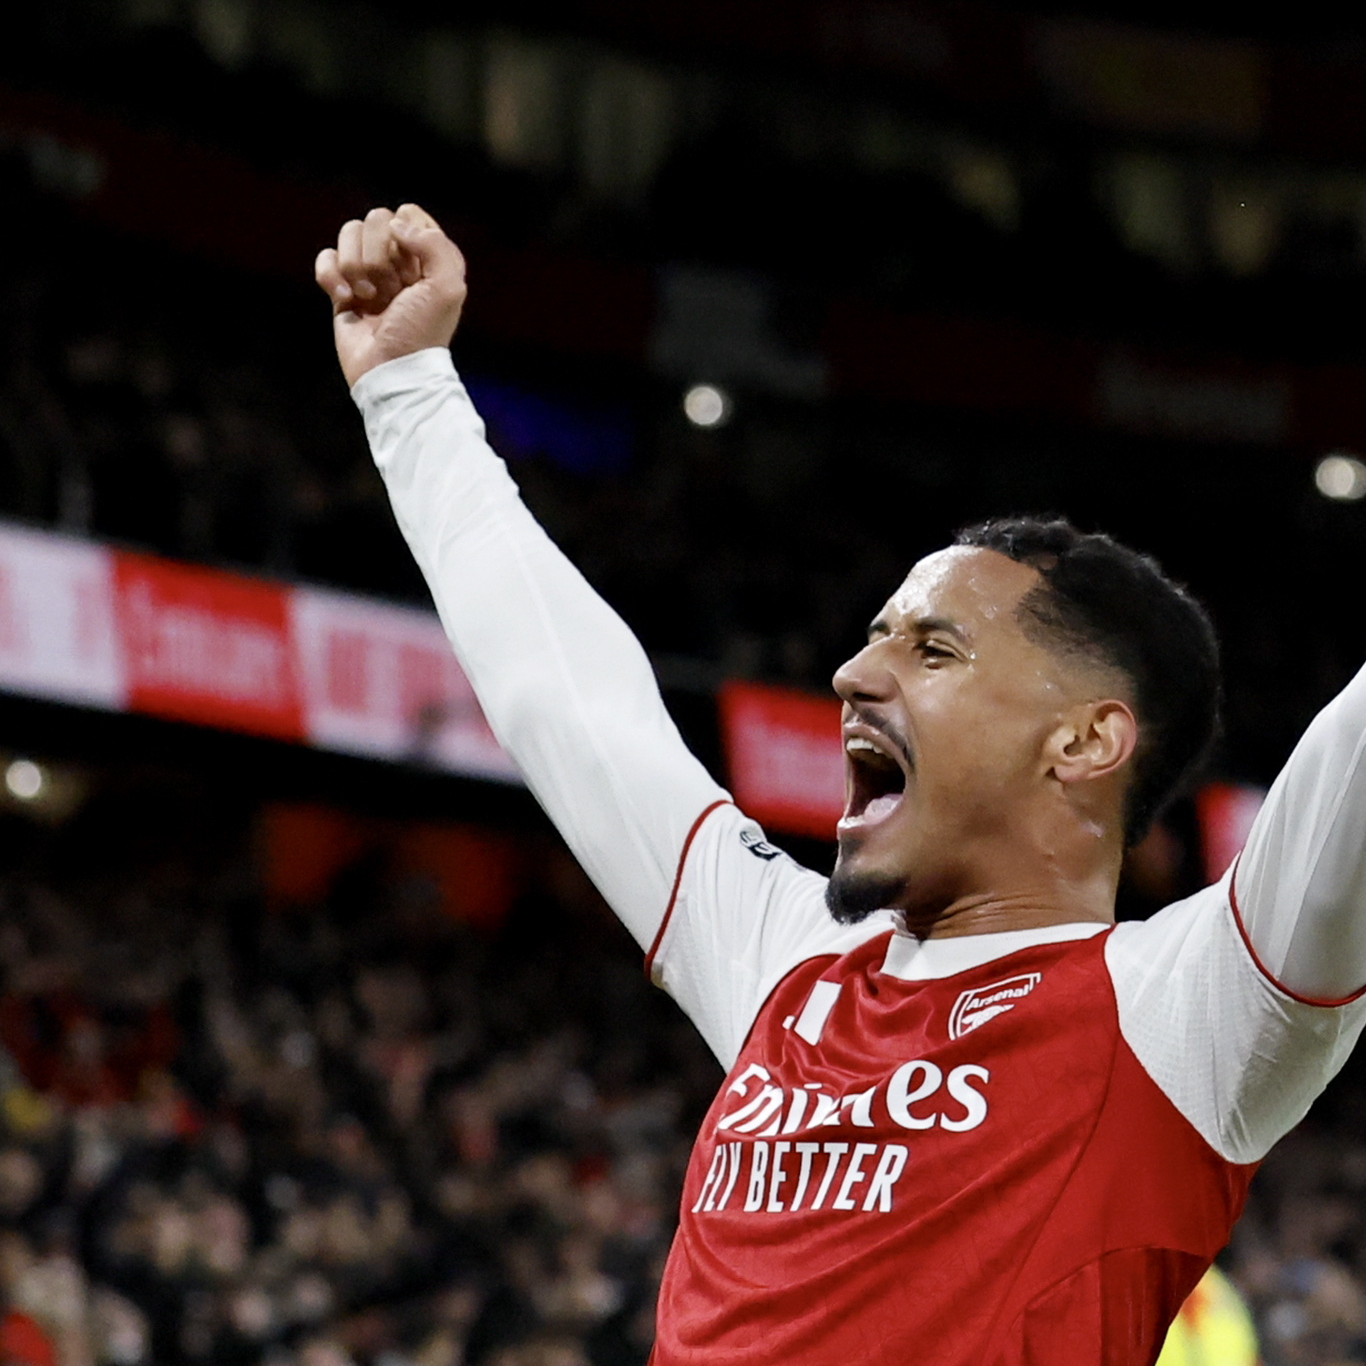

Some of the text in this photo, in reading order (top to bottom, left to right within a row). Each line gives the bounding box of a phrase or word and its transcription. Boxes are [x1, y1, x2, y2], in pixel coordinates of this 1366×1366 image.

[966, 984, 1029, 1011] Arsenal
[691, 1141, 909, 1213] FLY BETTER
